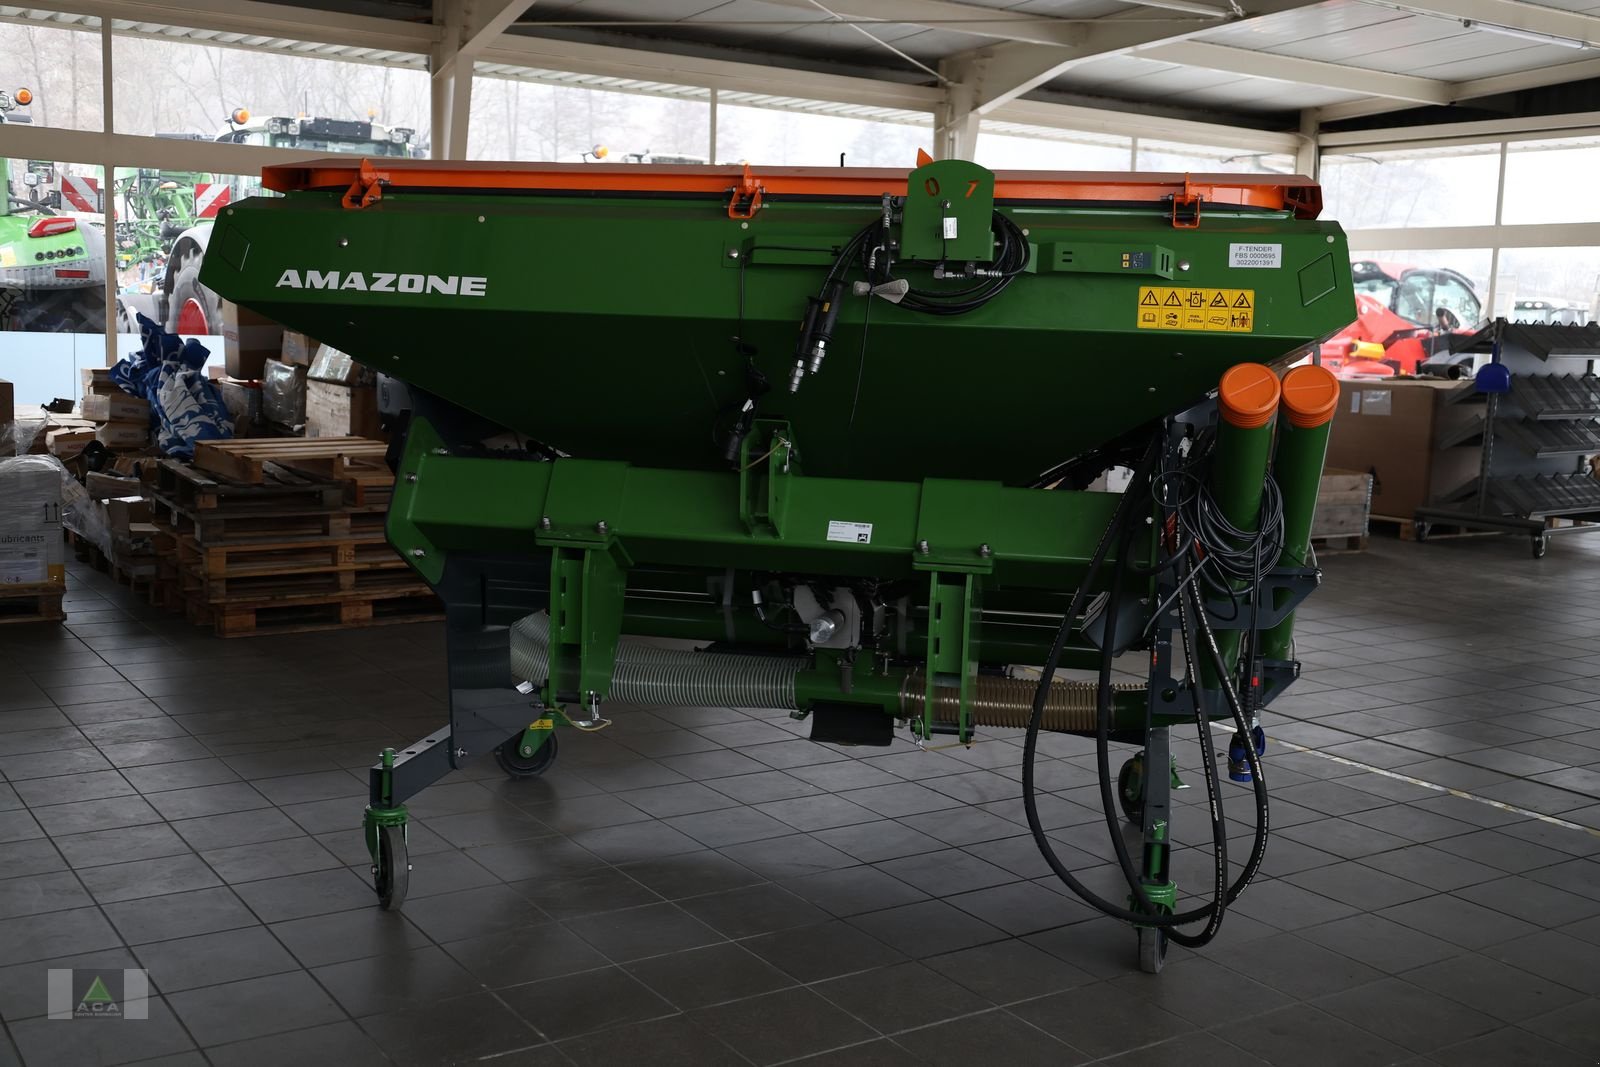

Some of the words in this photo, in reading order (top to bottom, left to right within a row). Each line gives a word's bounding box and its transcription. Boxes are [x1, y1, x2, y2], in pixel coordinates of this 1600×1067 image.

[925, 177, 939, 196] 0
[275, 269, 488, 297] AMAZONE
[0, 535, 45, 543] ubricants
